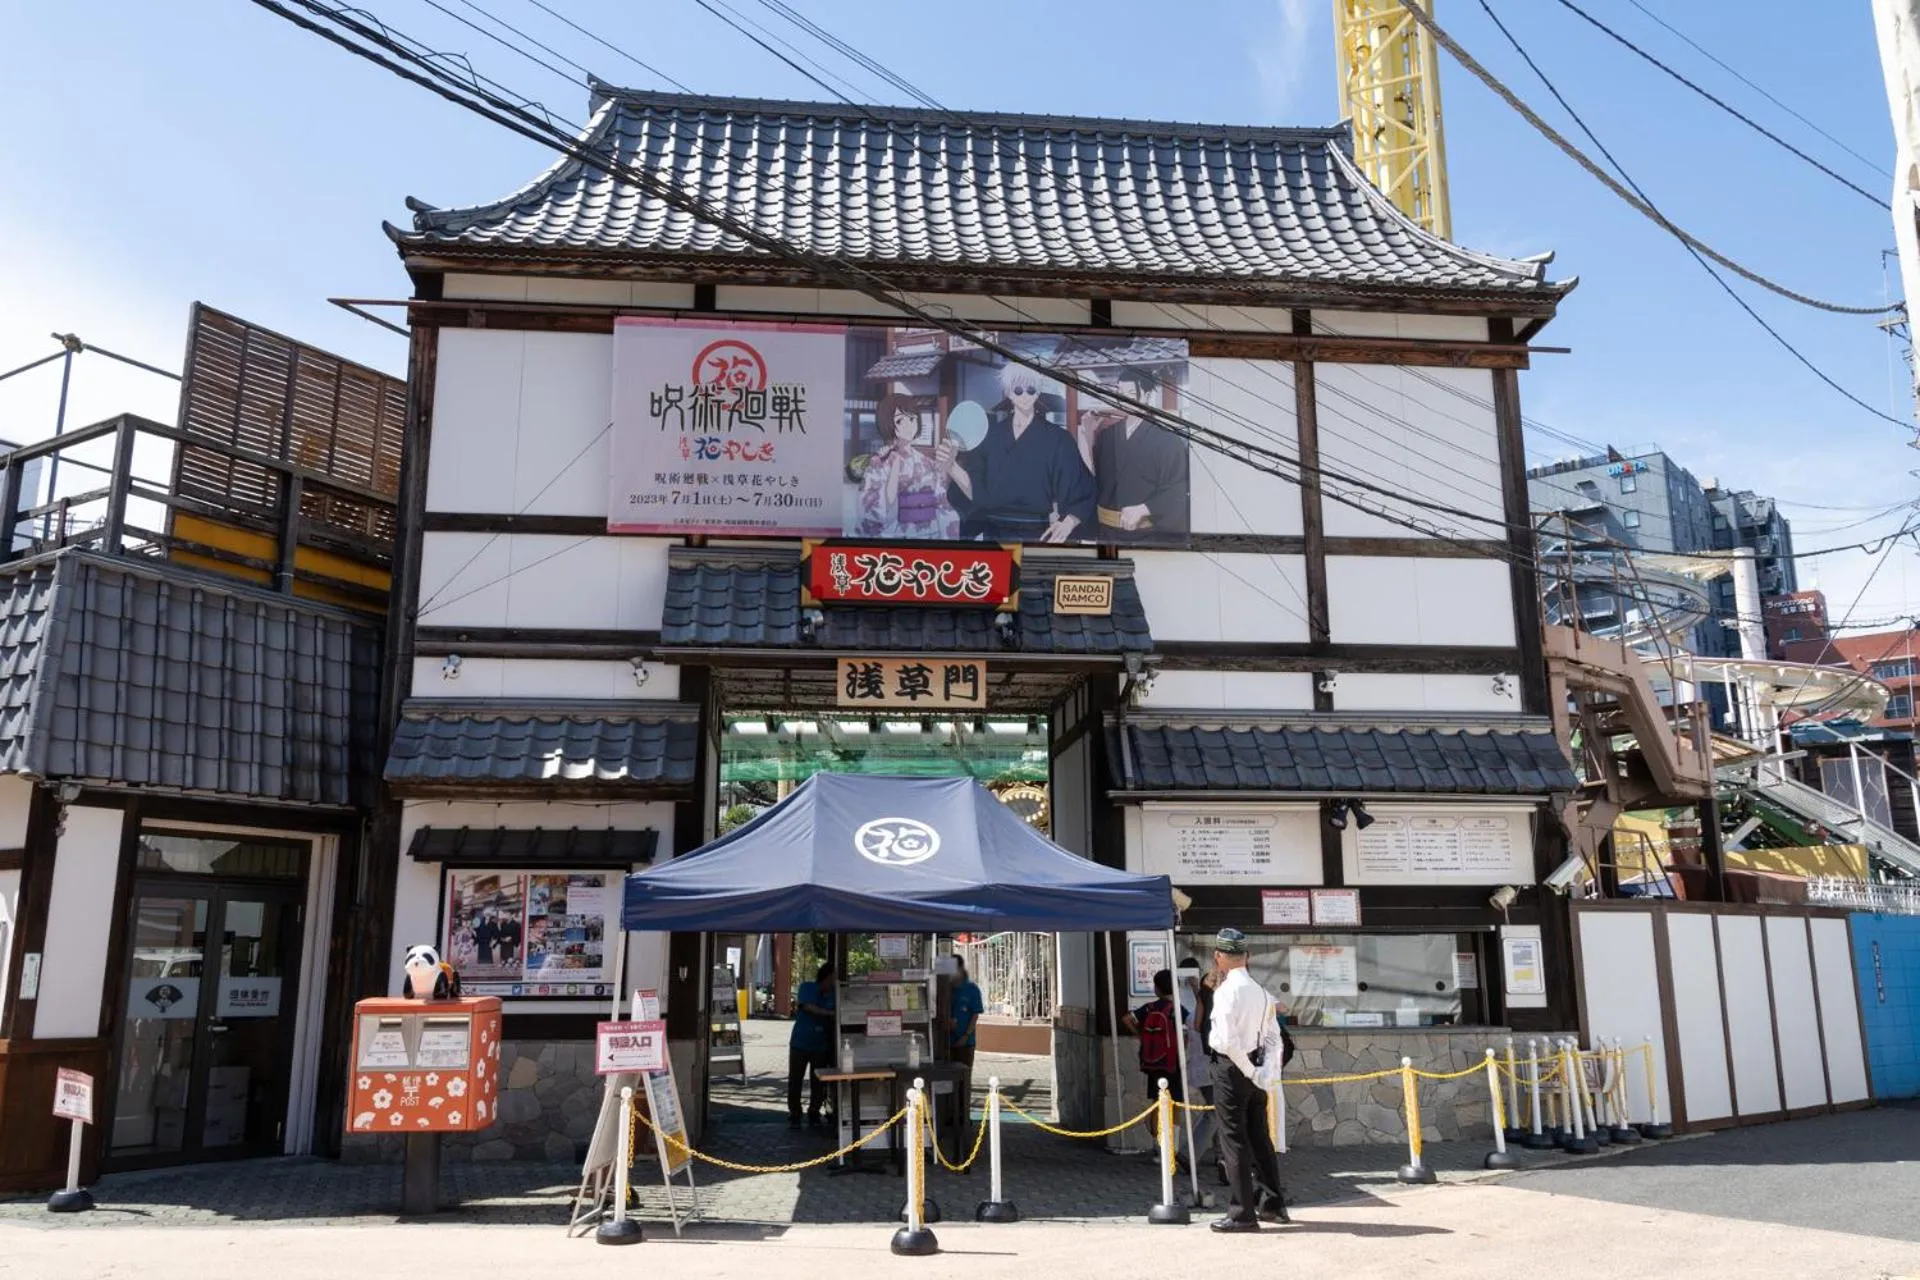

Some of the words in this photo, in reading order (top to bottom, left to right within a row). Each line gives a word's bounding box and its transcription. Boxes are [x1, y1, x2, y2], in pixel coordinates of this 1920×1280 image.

[650, 383, 807, 434] 呪術廻戦
[851, 552, 993, 598] 花やしき
[1062, 584, 1104, 594] BANDAI
[1062, 594, 1104, 603] NAMCO
[846, 662, 979, 702] 浅草門
